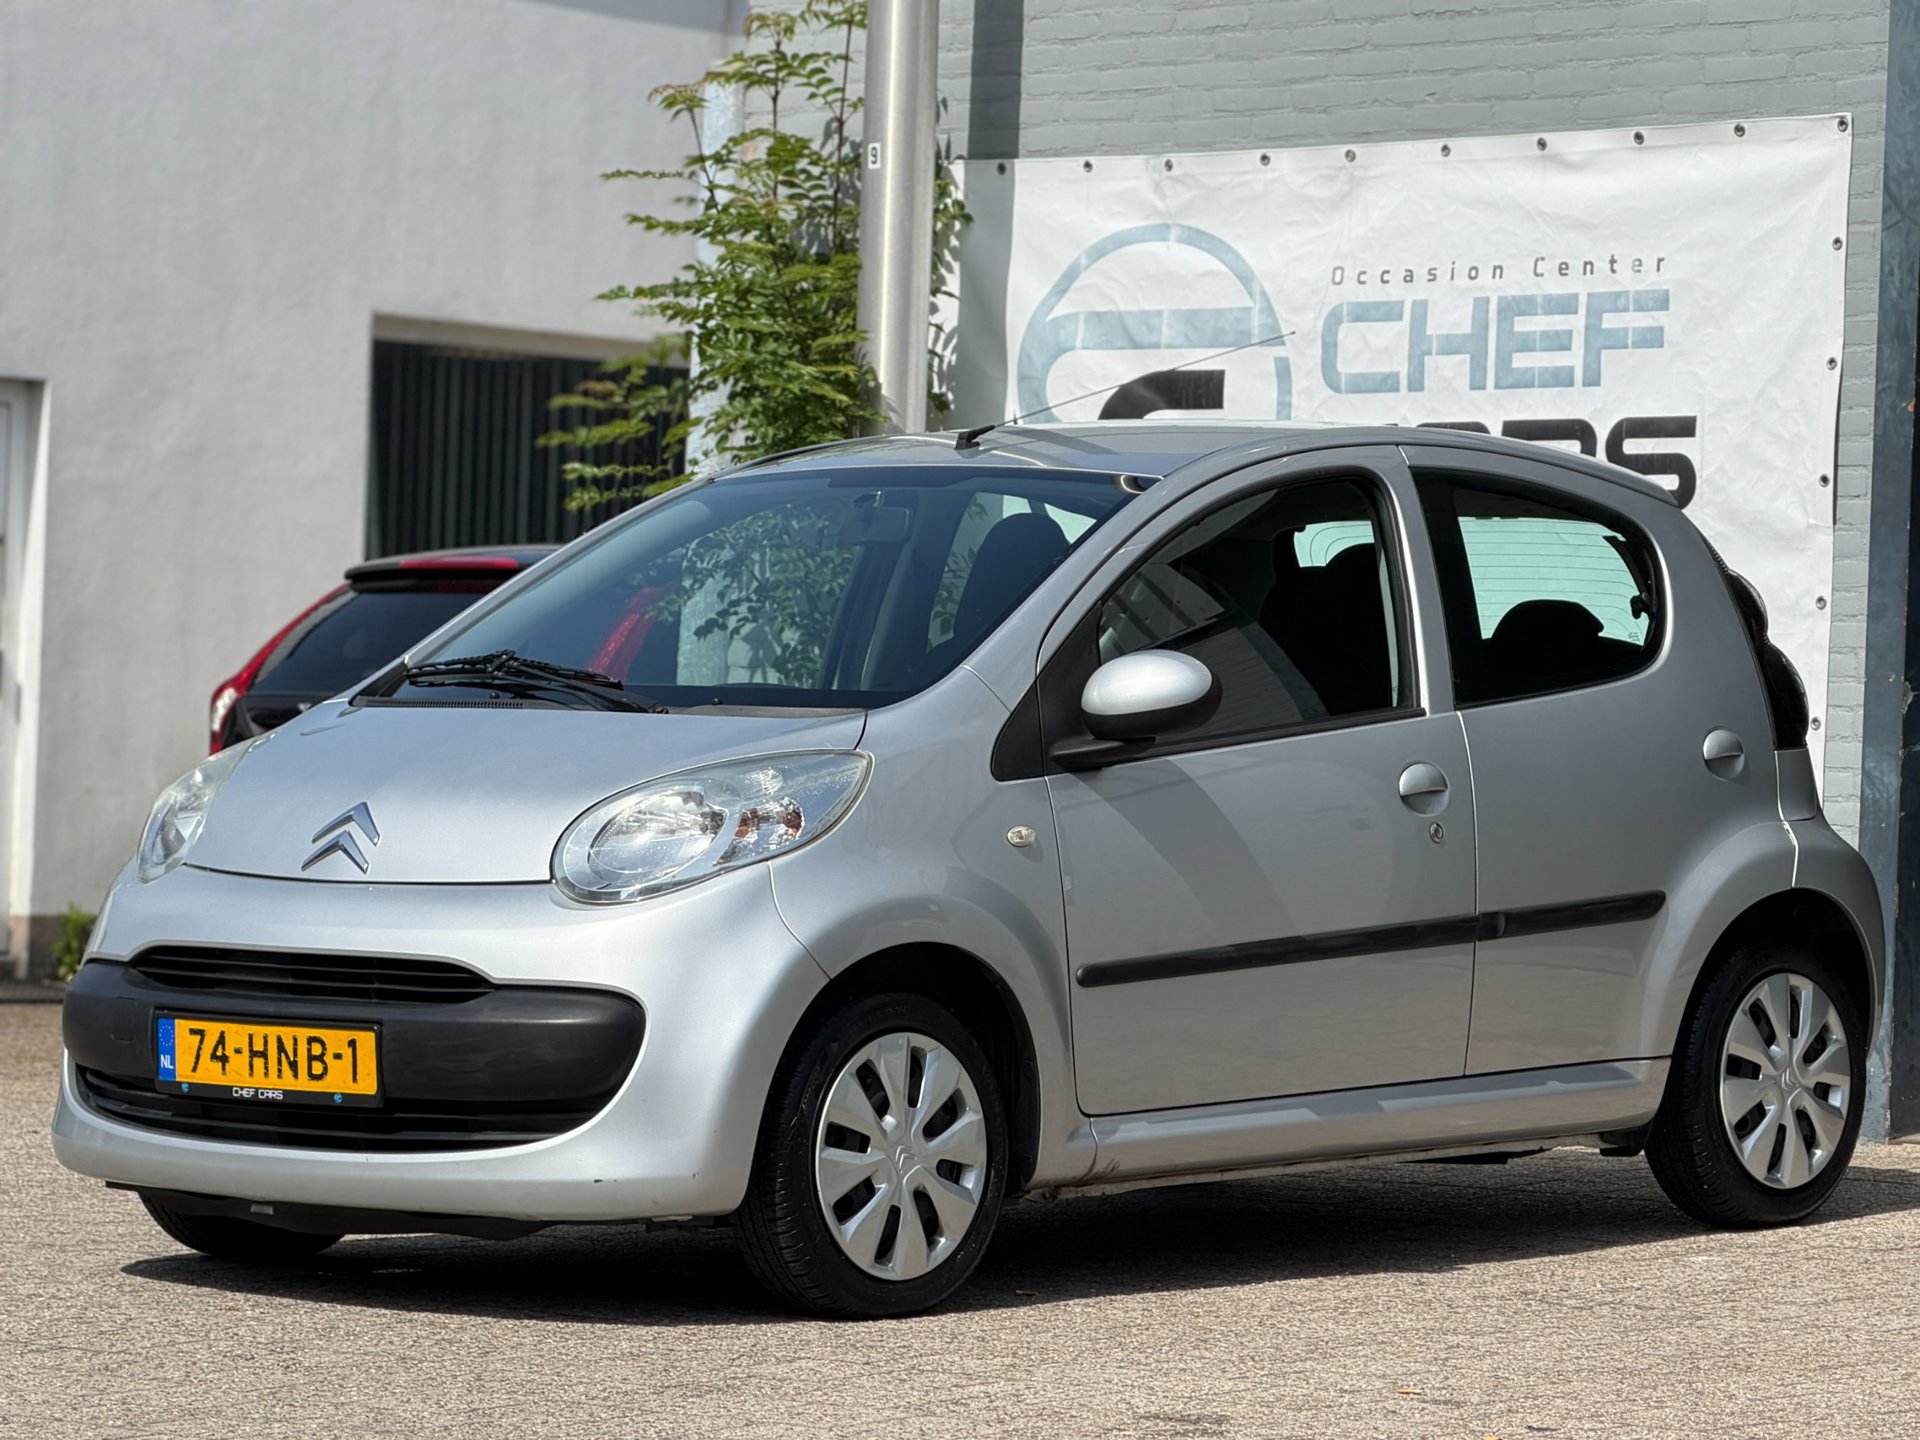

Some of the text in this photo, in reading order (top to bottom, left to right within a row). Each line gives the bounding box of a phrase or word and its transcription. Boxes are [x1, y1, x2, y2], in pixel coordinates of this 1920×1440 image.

[870, 146, 877, 165] 9
[1331, 253, 1665, 286] Occasion Center
[1320, 288, 1670, 394] CHEF
[160, 1054, 174, 1070] NL
[188, 1027, 359, 1084] 74-HNB-1
[232, 1087, 284, 1100] CHEF CARS
